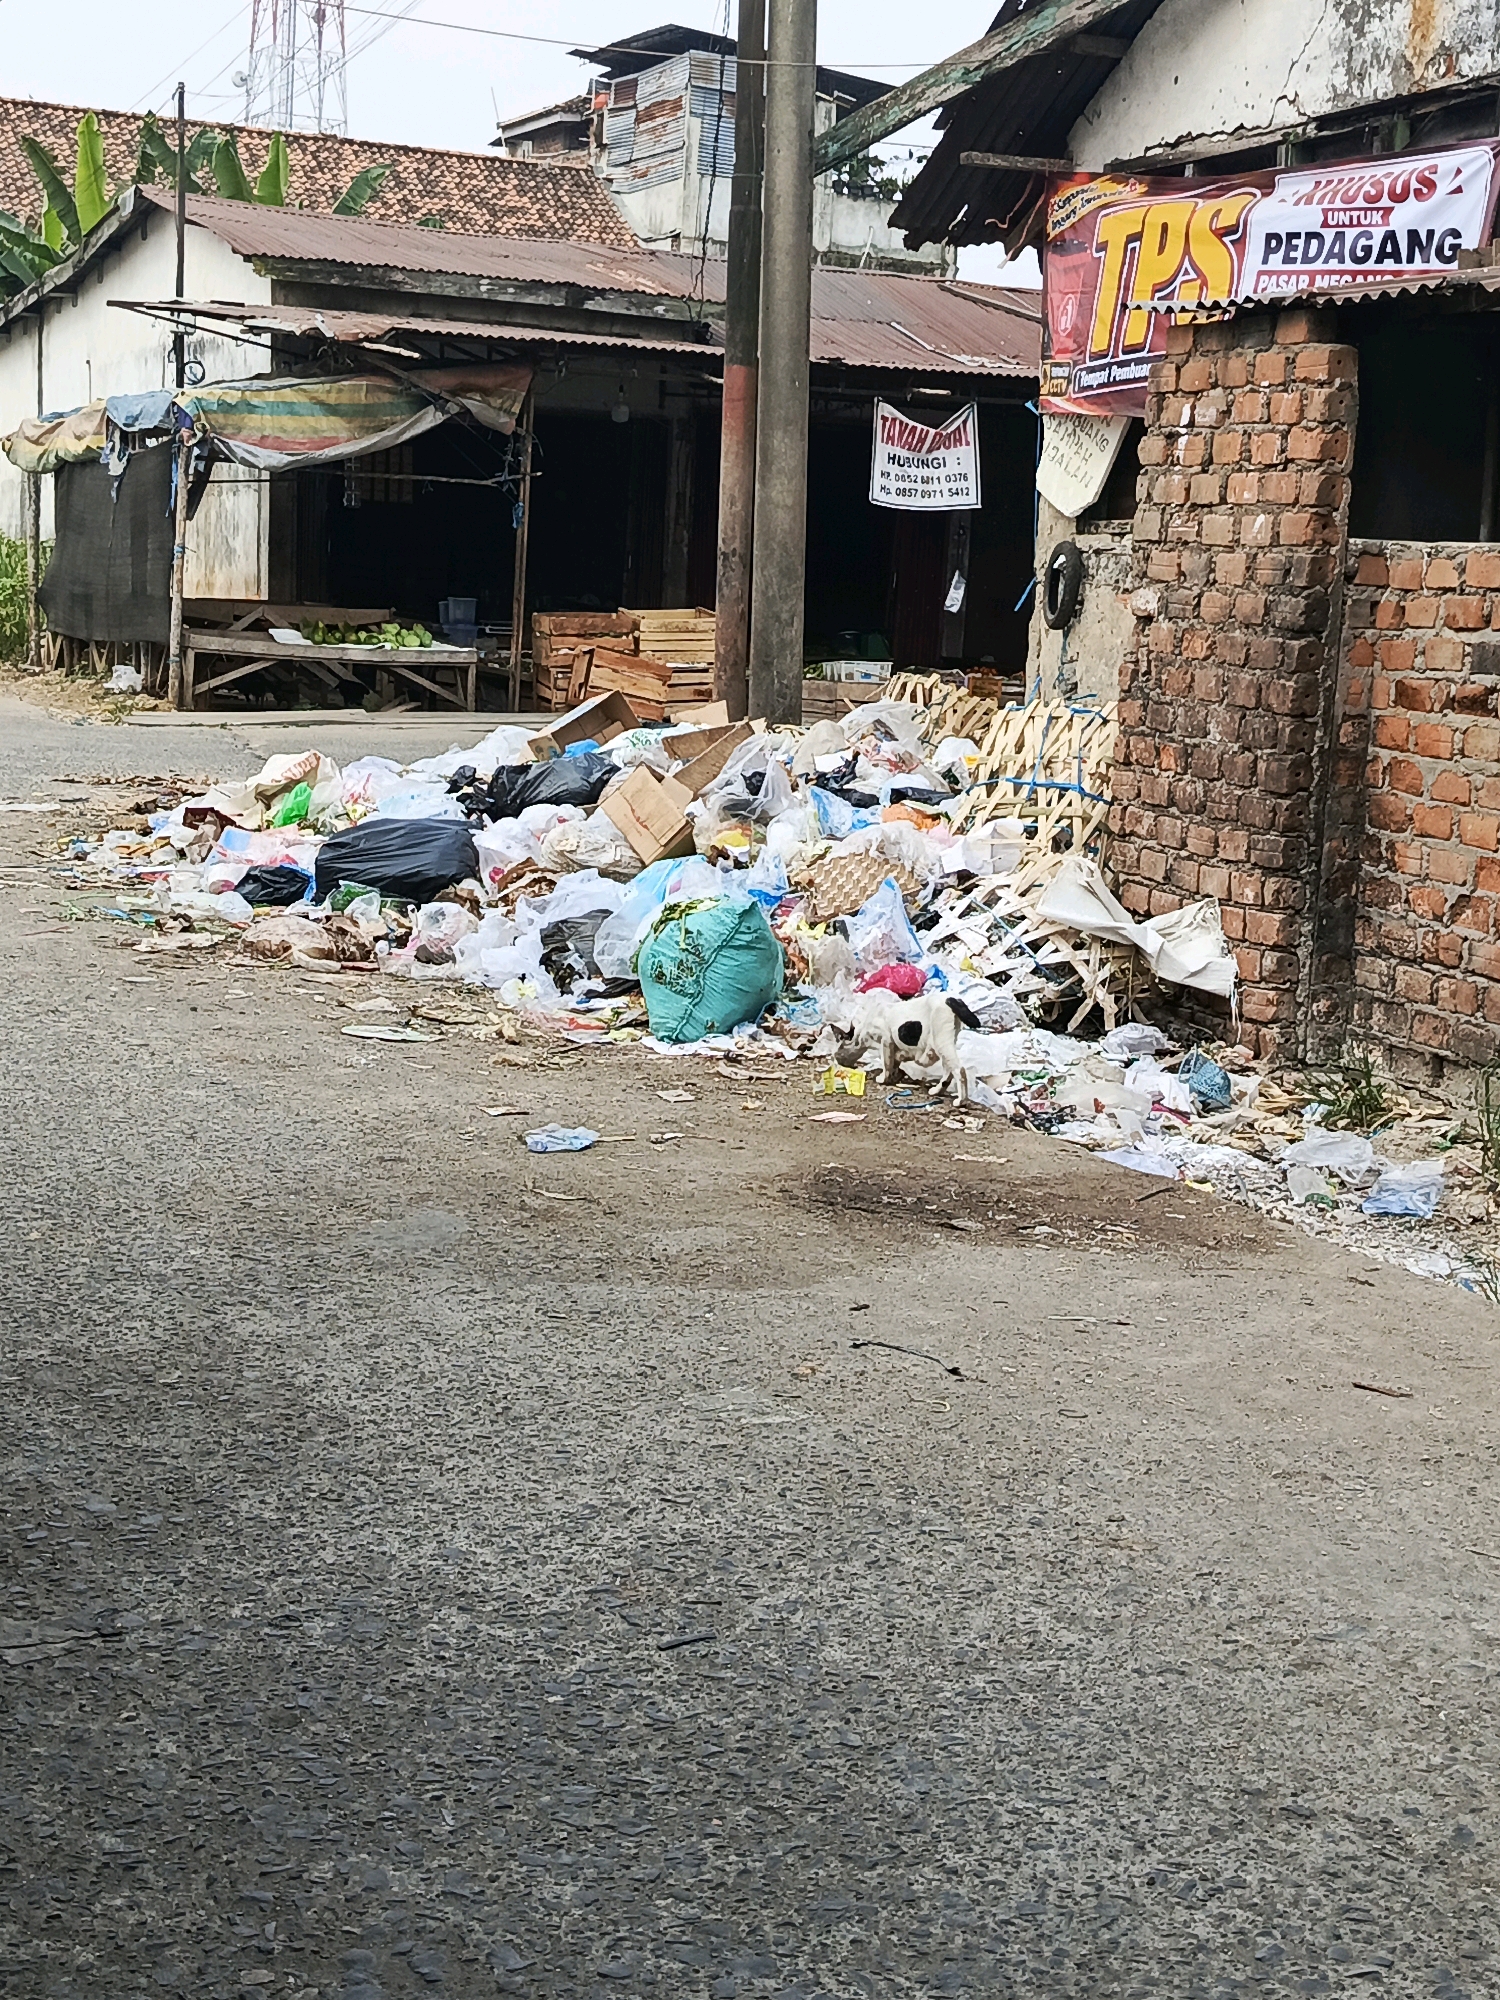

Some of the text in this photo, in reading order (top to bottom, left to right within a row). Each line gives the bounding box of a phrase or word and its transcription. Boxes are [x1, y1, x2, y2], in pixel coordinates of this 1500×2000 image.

[1327, 209, 1384, 226] UNTUK
[1261, 227, 1463, 265] PEDAGANG
[1090, 194, 1254, 353] TPS
[1257, 274, 1309, 293] PASAR
[881, 414, 930, 454] TANAH
[887, 452, 947, 469] HUBUNGI
[895, 487, 919, 498] 0857
[920, 488, 944, 499] 0971
